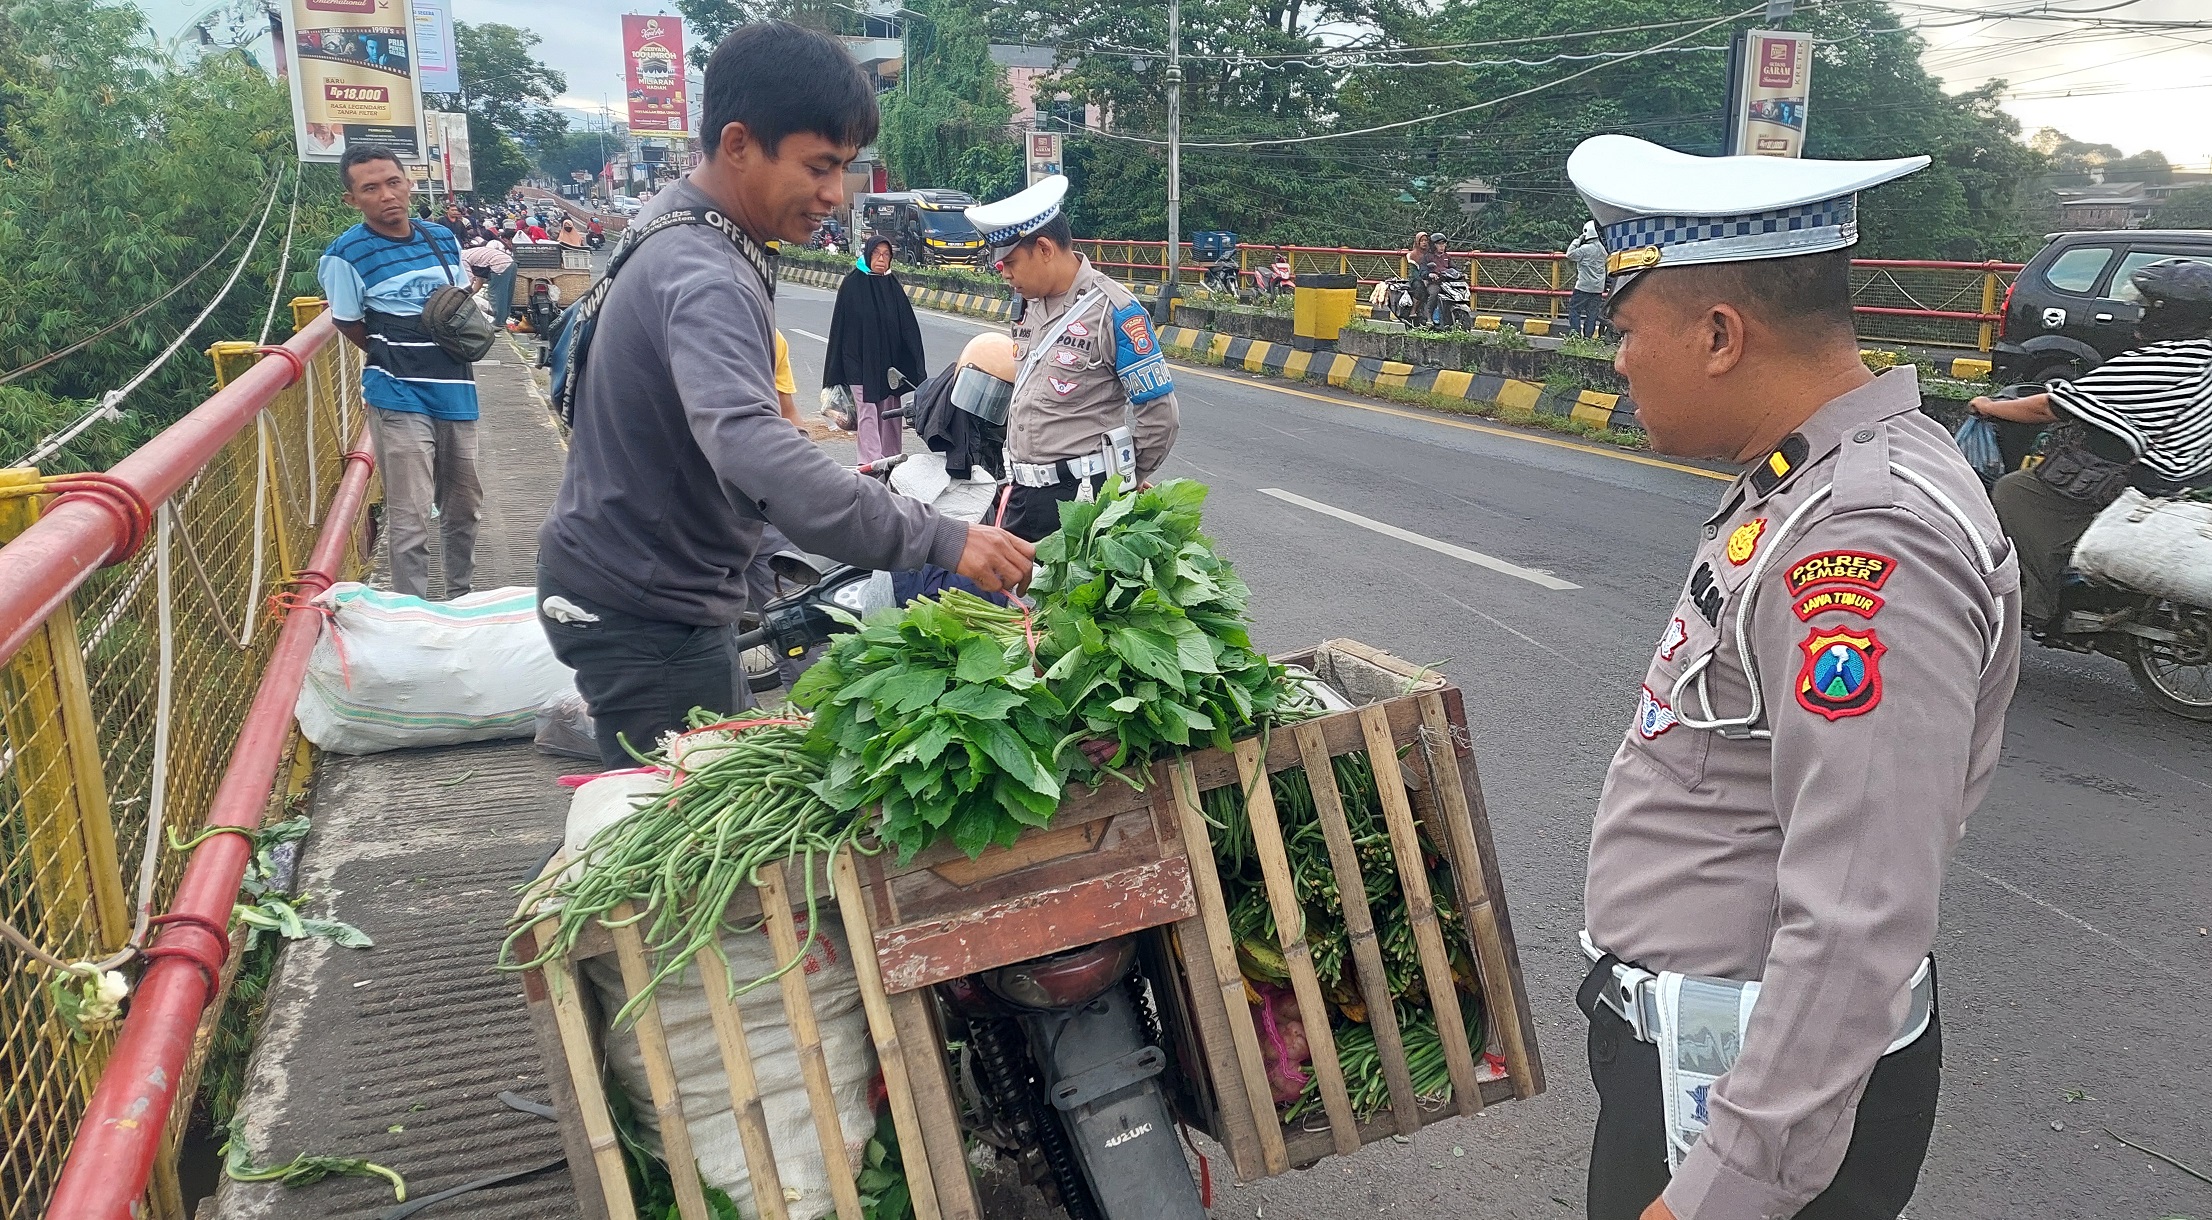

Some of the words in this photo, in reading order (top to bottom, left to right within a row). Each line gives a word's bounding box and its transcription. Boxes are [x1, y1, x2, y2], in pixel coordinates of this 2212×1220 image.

[388, 38, 405, 47] PRIA
[1763, 66, 1791, 76] GARAM
[1057, 335, 1091, 351] POLRI
[1793, 555, 1883, 580] POLRES
[1798, 566, 1871, 586] JEMBER
[1802, 593, 1832, 614] JAWA
[1834, 592, 1874, 611] TIMUR
